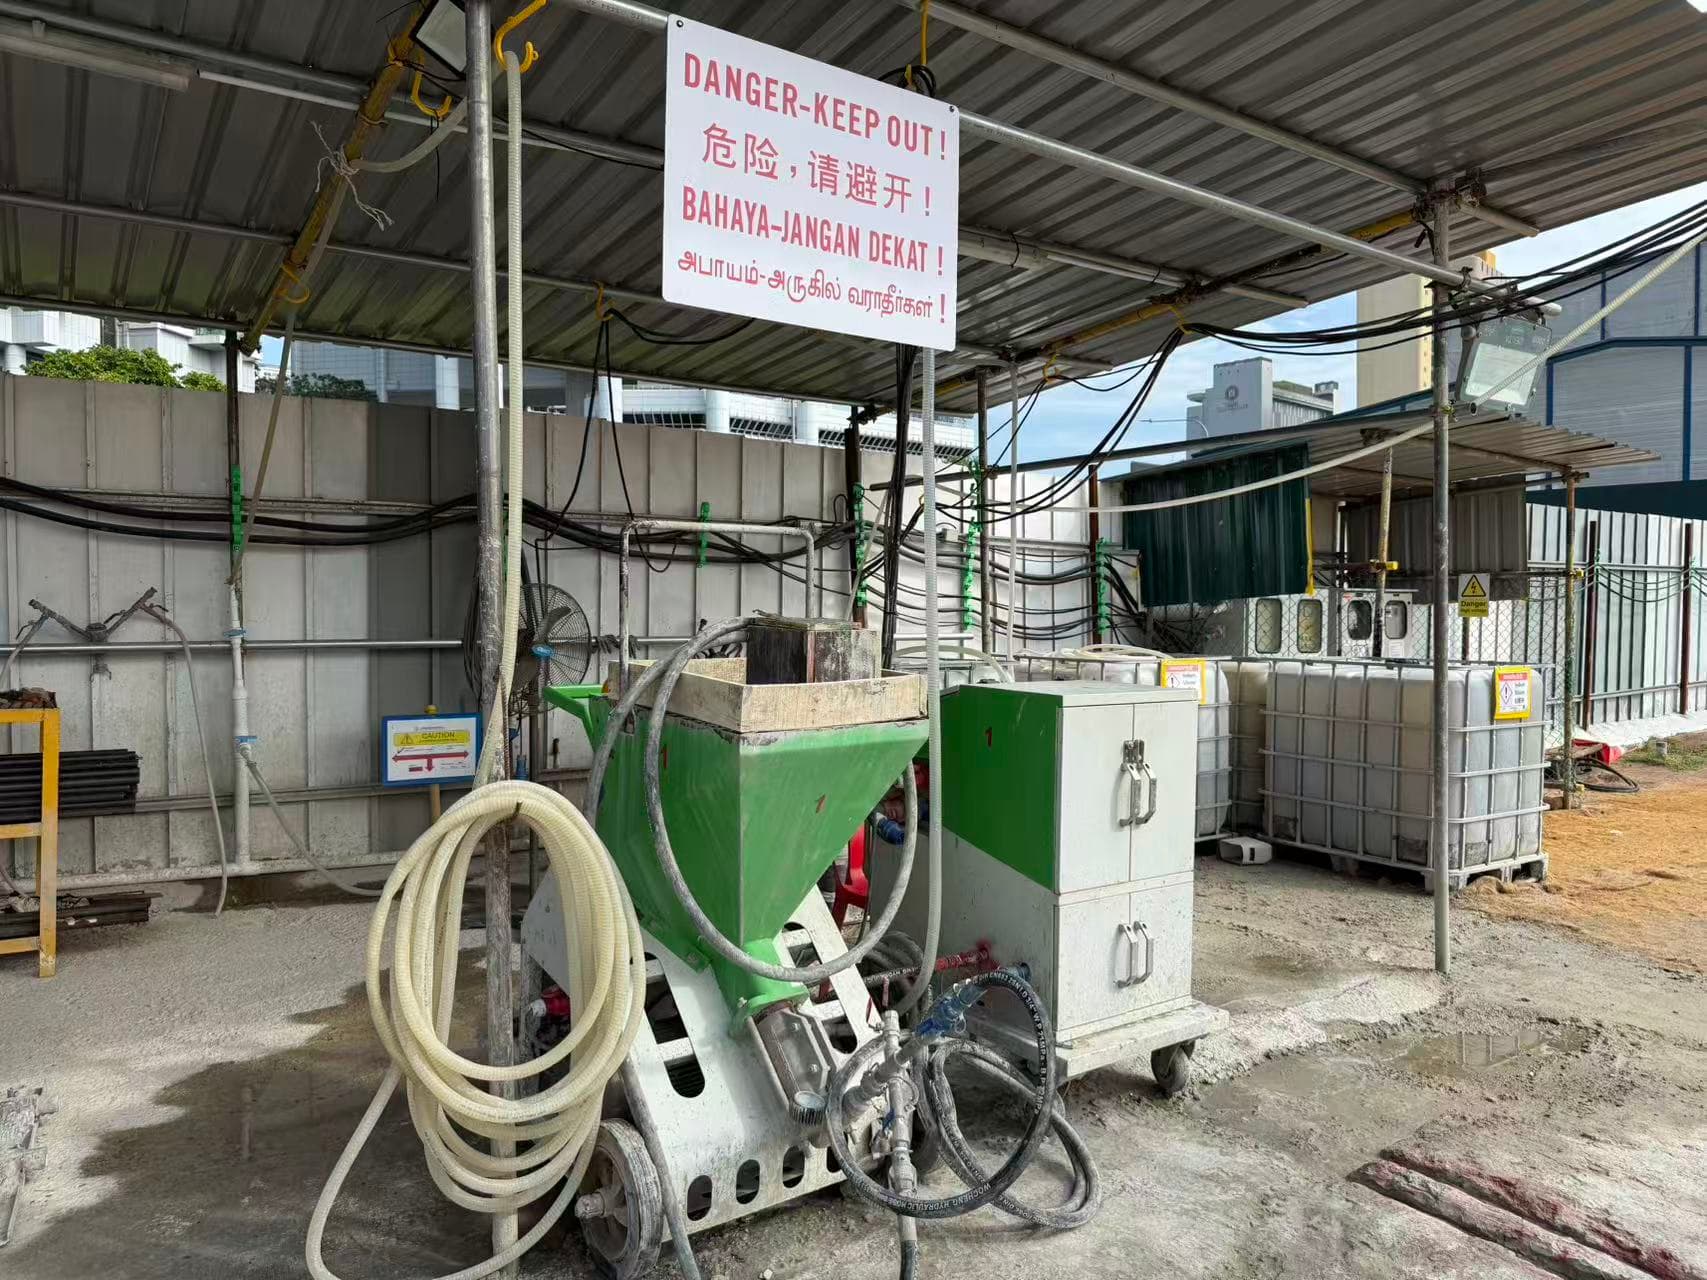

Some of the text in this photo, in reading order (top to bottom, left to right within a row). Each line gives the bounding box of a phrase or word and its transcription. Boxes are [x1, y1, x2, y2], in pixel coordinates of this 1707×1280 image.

[684, 52, 880, 139] DANGER-KEEP
[682, 185, 860, 259] BAHAYA-JANGAN
[1461, 600, 1486, 608] Danger
[421, 731, 455, 739] CAUTION
[952, 1183, 992, 1207] WOCHENG
[907, 1201, 951, 1211] HYDRAULIC
